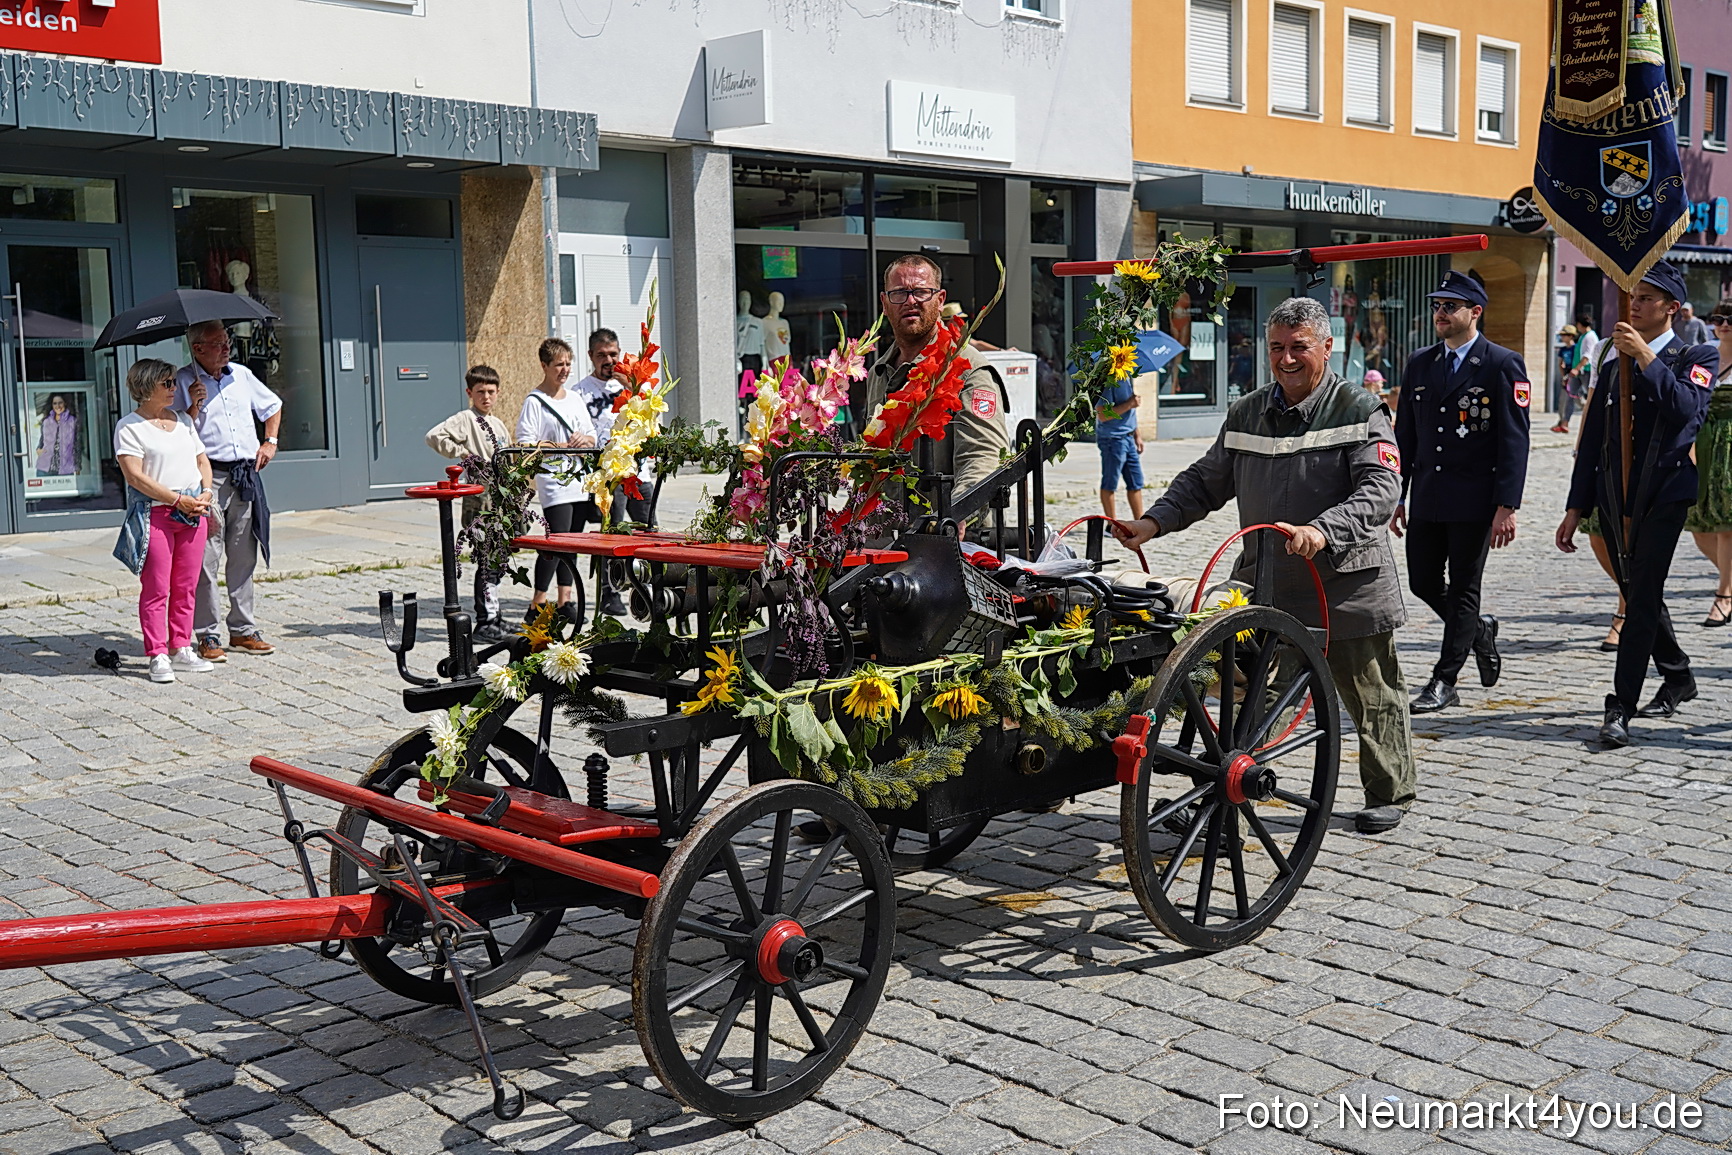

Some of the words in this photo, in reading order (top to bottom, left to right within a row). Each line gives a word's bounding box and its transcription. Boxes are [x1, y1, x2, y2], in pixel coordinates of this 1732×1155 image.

[1568, 9, 1617, 25] Patenverein
[1572, 23, 1611, 37] Freiwillige
[1572, 35, 1610, 50] Feuerwehr
[1562, 48, 1619, 66] Reichertshofen
[711, 66, 758, 97] Mittendrin
[916, 91, 993, 140] Mittendrin
[1289, 181, 1387, 216] hunkemöller
[622, 243, 632, 254] 29
[25, 339, 52, 347] erzlich
